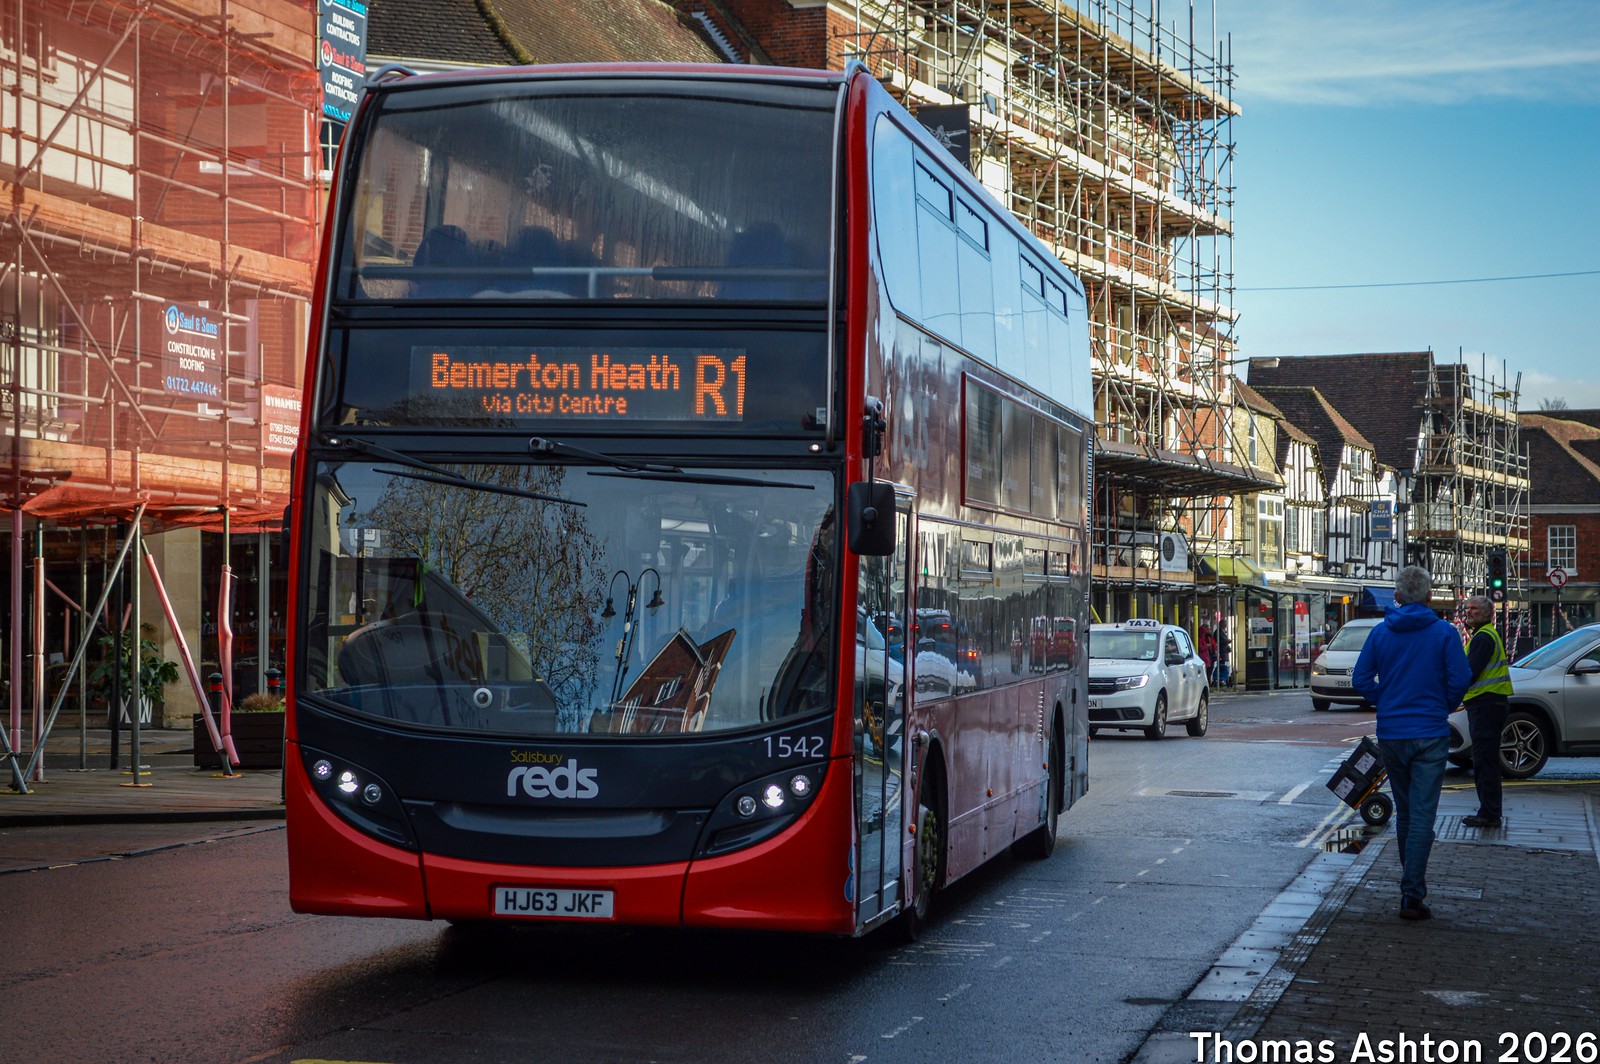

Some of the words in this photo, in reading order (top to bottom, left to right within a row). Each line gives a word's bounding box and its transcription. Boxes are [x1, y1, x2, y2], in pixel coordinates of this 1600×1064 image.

[332, 12, 355, 31] BUILDING
[326, 23, 360, 46] CONTRACTORS
[350, 54, 365, 74] Sons
[331, 71, 353, 89] ROOFING
[325, 82, 358, 104] CONTRACTORS
[179, 311, 194, 330] Saul
[201, 316, 218, 336] Sons
[167, 340, 210, 359] CONSTRUCTION
[210, 348, 216, 361] &
[180, 357, 205, 373] ROOFING
[431, 353, 580, 389] Bemerton
[591, 354, 680, 390] Heath
[166, 376, 190, 393] 01722
[190, 380, 217, 397] 447414
[694, 355, 747, 416] R1
[265, 395, 302, 412] DYNAMITE
[482, 393, 512, 413] via
[516, 393, 554, 414] City
[559, 394, 627, 414] Centre
[1128, 620, 1157, 628] TAXI
[510, 750, 563, 765] Salisbury
[763, 736, 824, 759] 1542
[507, 758, 599, 799] reds
[504, 891, 558, 912] HJ63
[564, 893, 604, 913] JKF
